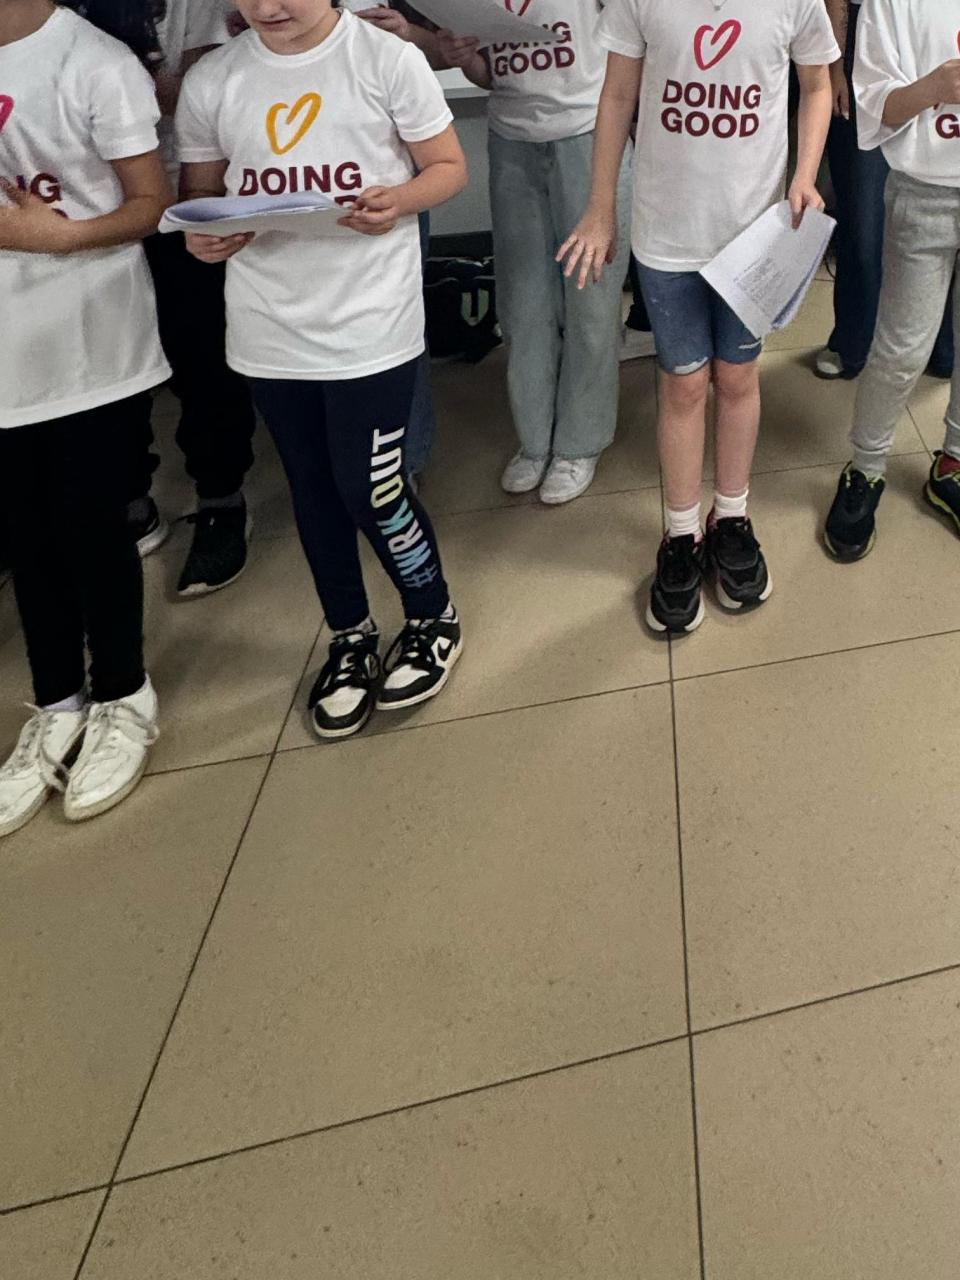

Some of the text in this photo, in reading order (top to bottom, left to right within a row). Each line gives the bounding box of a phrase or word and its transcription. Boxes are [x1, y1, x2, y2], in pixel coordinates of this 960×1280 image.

[494, 46, 575, 76] GOOD
[662, 79, 761, 111] DOING
[660, 110, 759, 139] GOOD
[239, 161, 362, 196] DOING
